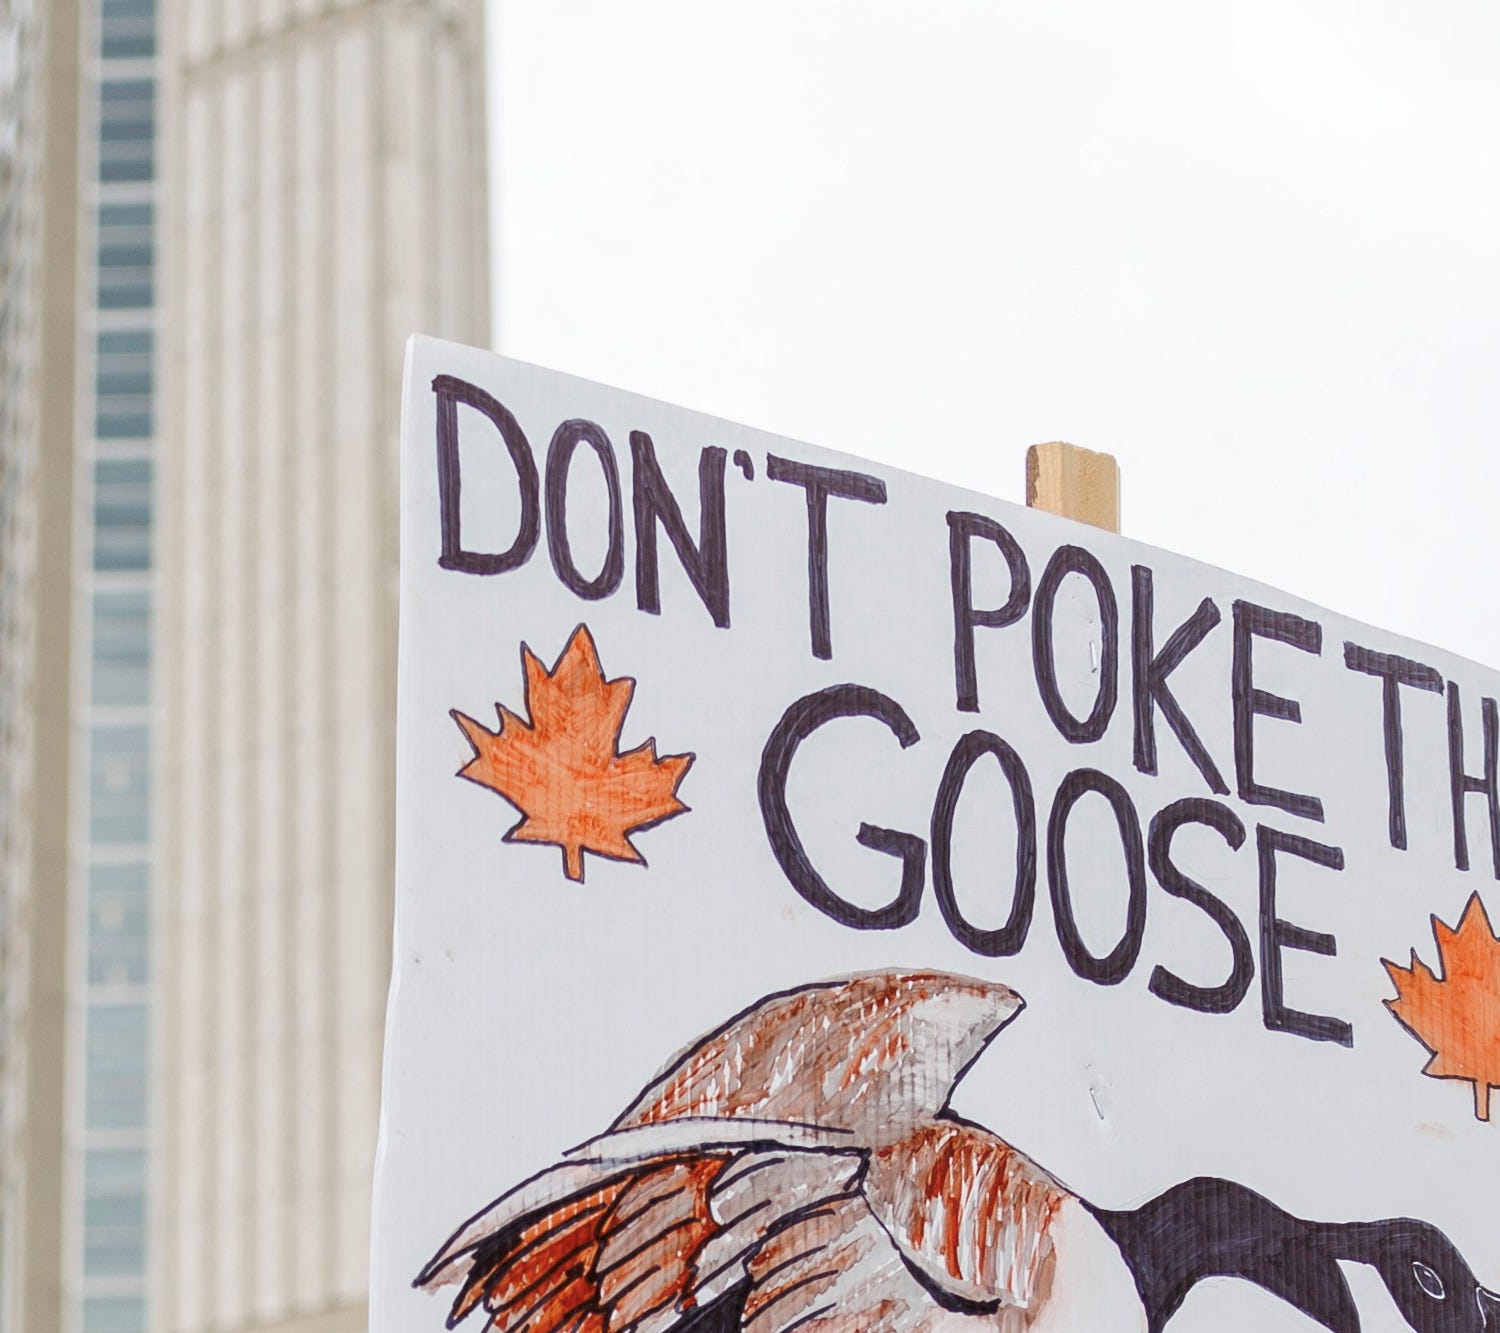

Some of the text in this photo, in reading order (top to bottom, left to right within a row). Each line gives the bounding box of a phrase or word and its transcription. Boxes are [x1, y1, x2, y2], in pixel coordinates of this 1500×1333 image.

[432, 375, 887, 660] DON'T
[946, 511, 1324, 823] POKE
[758, 683, 1353, 1048] GOOSE
